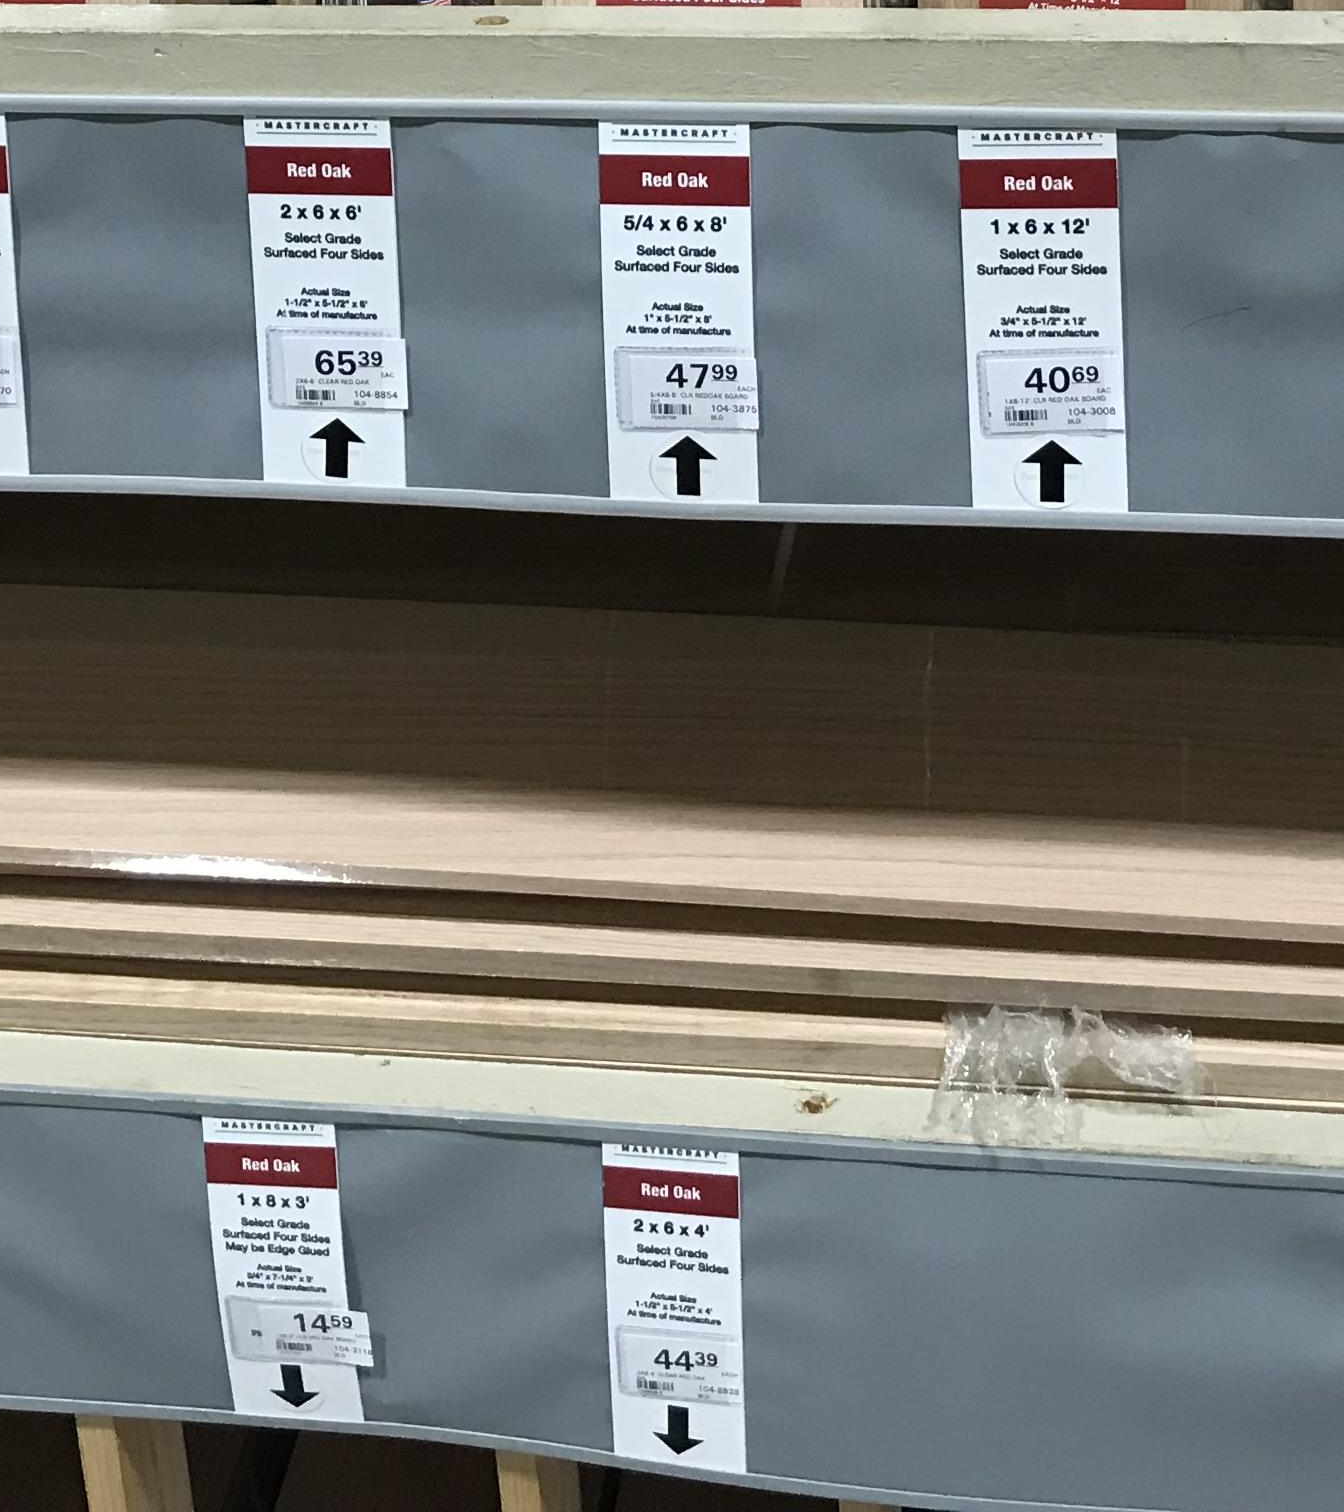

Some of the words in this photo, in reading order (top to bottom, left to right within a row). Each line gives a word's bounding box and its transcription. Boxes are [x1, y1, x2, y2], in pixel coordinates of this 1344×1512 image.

[287, 163, 317, 177] Red
[322, 164, 351, 178] Oak
[641, 173, 673, 187] Red
[678, 173, 708, 188] Oak
[1004, 177, 1036, 190] Red
[1041, 177, 1074, 191] Oak
[242, 1157, 269, 1171] Red
[273, 1159, 300, 1173] Oak
[641, 1183, 668, 1198] Red
[672, 1185, 701, 1201] Oak
